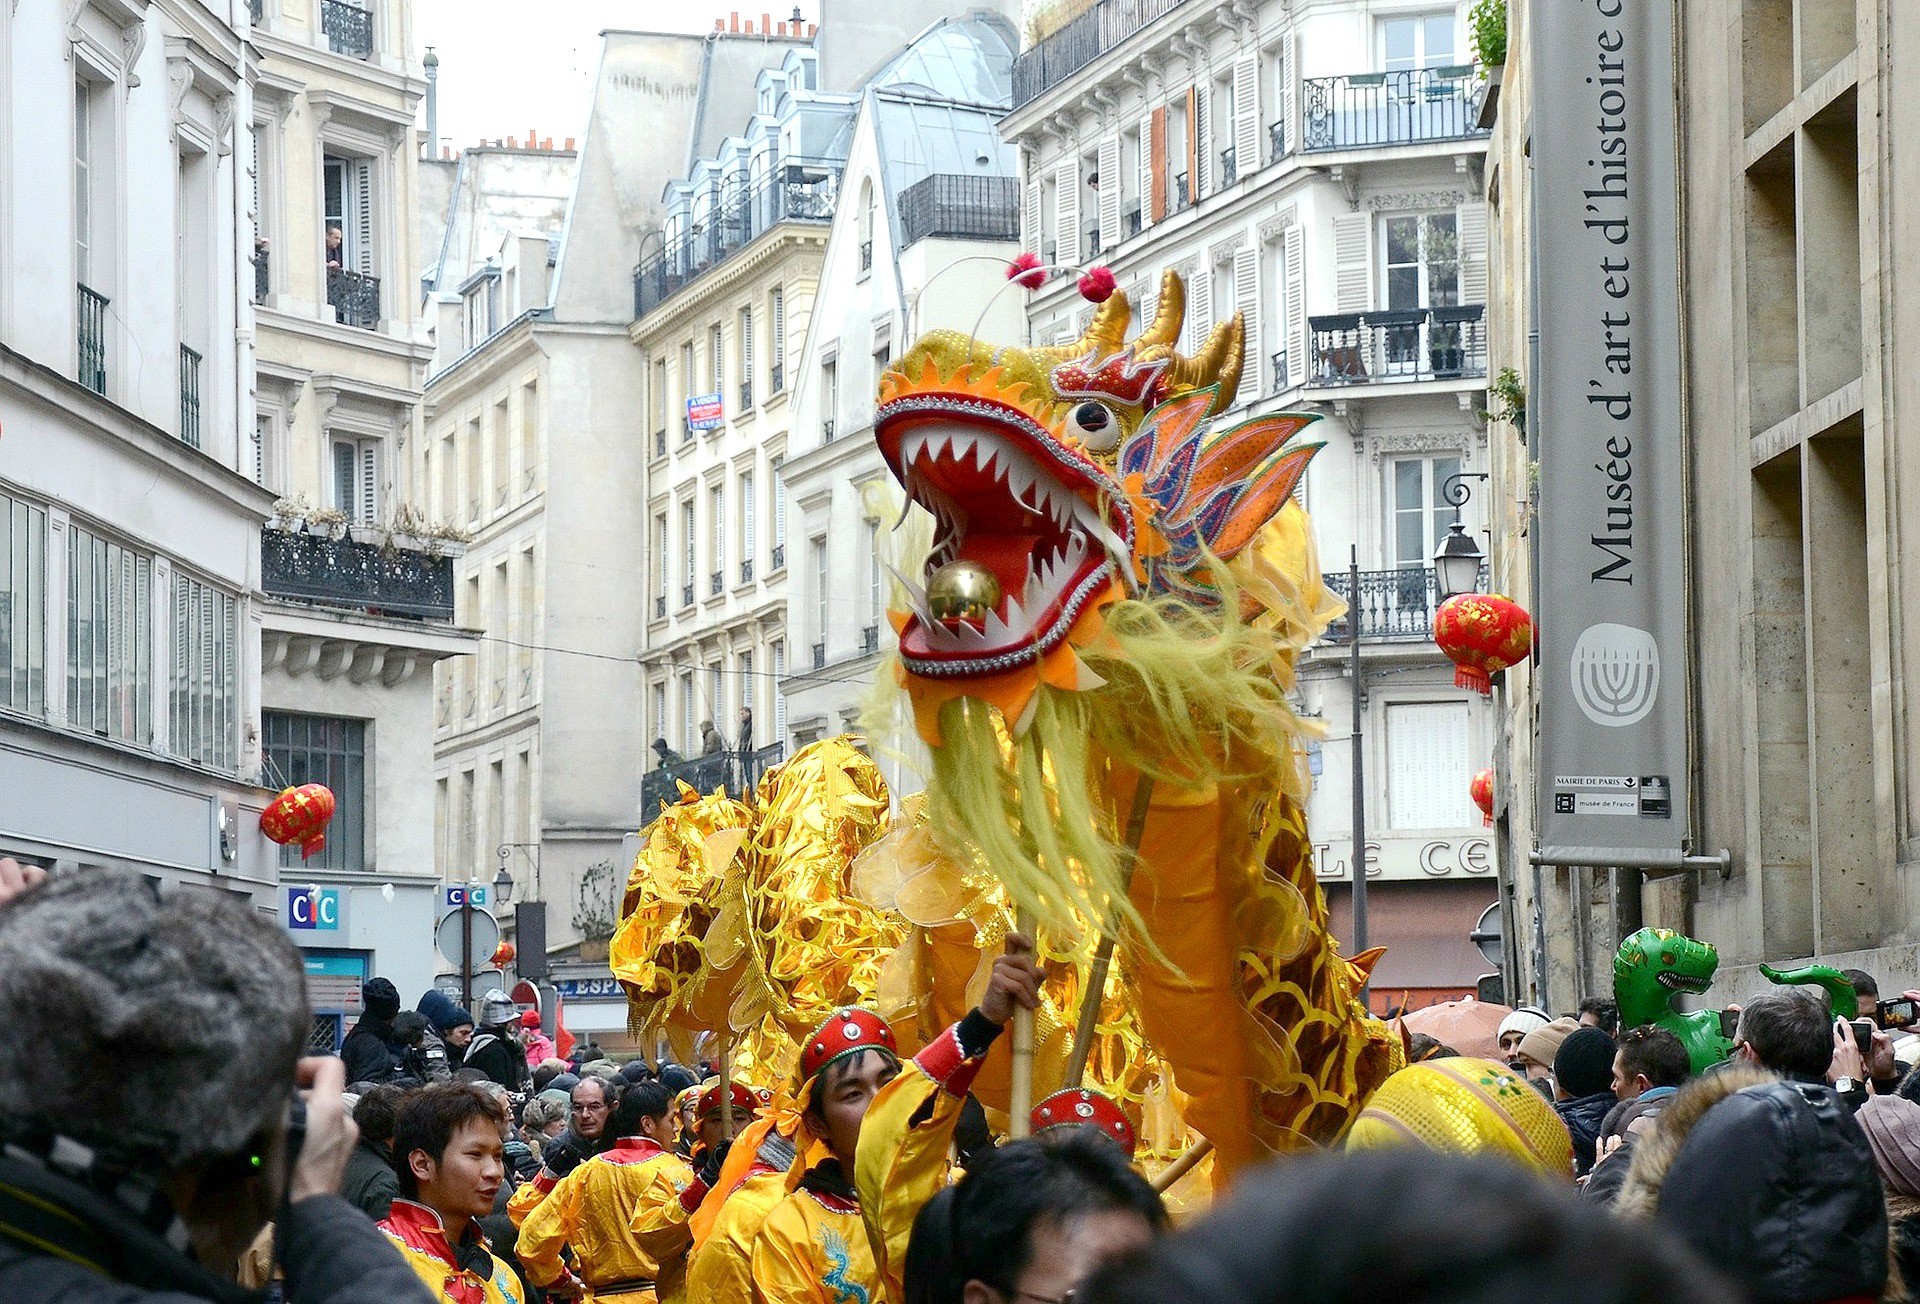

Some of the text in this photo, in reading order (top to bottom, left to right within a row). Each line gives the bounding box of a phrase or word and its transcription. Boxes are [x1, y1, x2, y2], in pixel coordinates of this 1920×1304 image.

[1583, 30, 1630, 245] d'histoire
[1599, 256, 1631, 299] et
[1586, 311, 1632, 421] d'art
[1590, 435, 1633, 586] Musée
[292, 894, 336, 924] CIC
[449, 889, 484, 904] CIC
